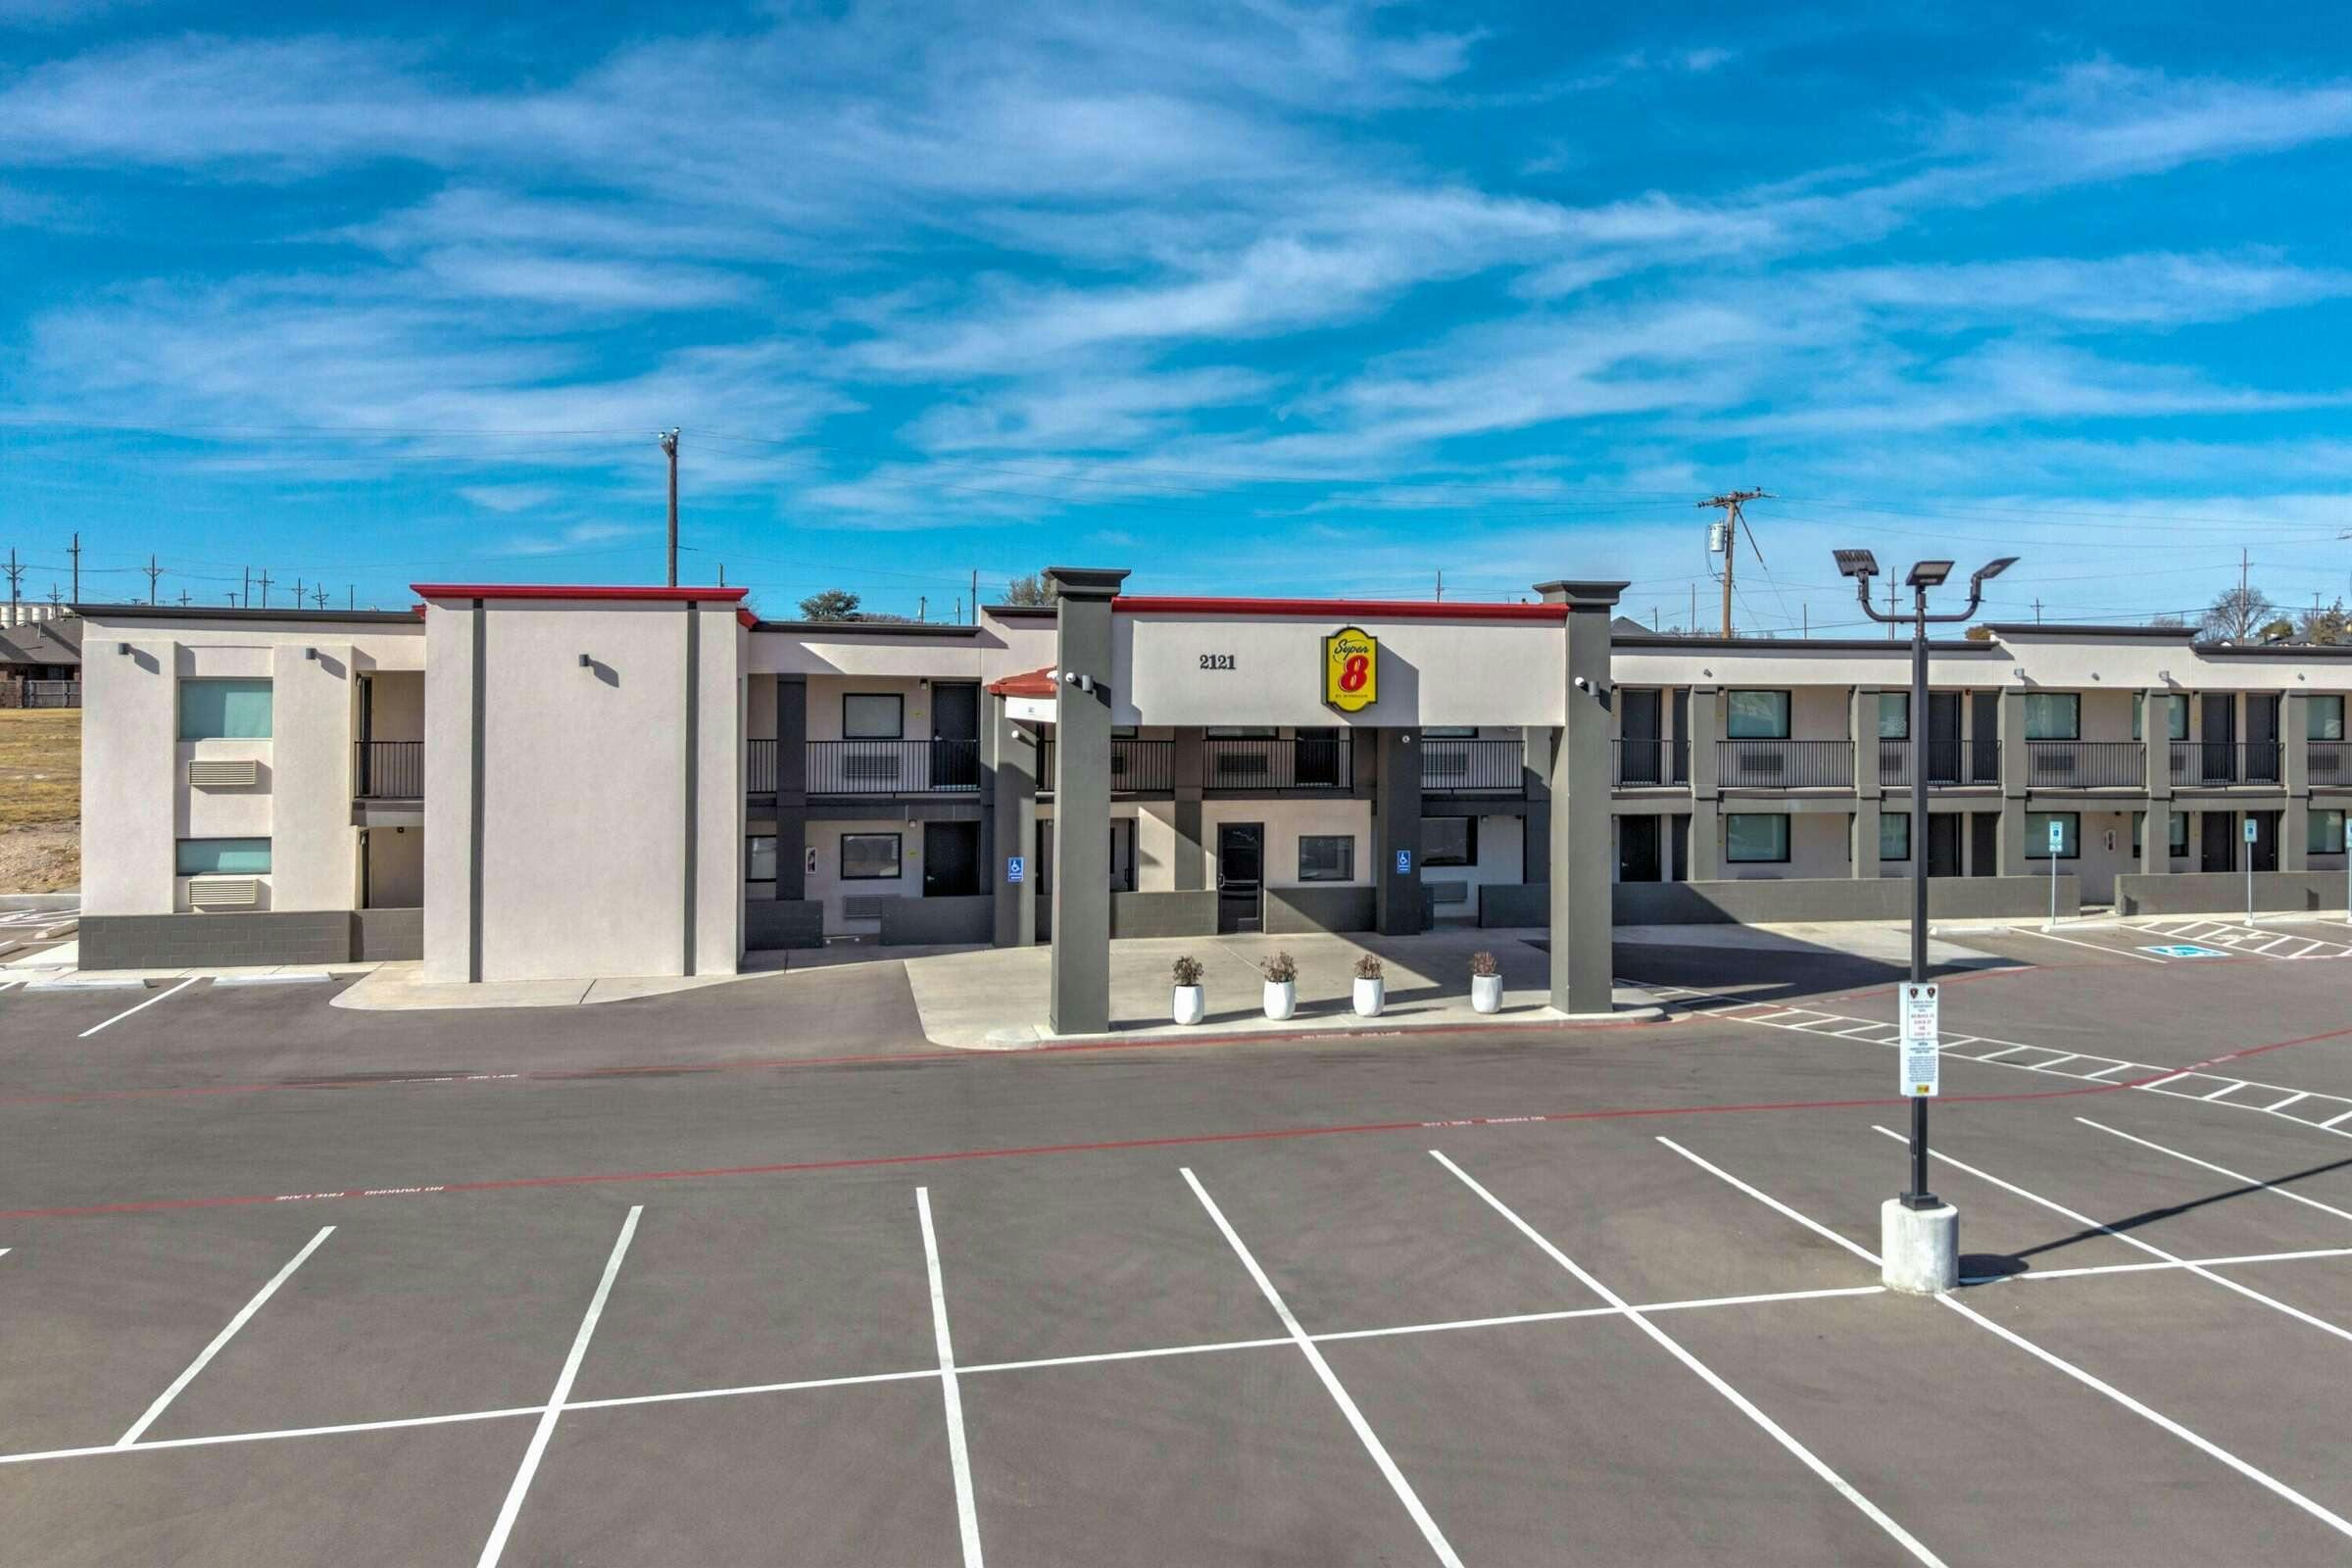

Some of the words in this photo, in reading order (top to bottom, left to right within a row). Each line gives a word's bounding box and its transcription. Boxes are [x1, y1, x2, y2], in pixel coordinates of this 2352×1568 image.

[1334, 638, 1369, 661] Super
[1200, 655, 1236, 669] 2121
[1338, 655, 1369, 692] 8
